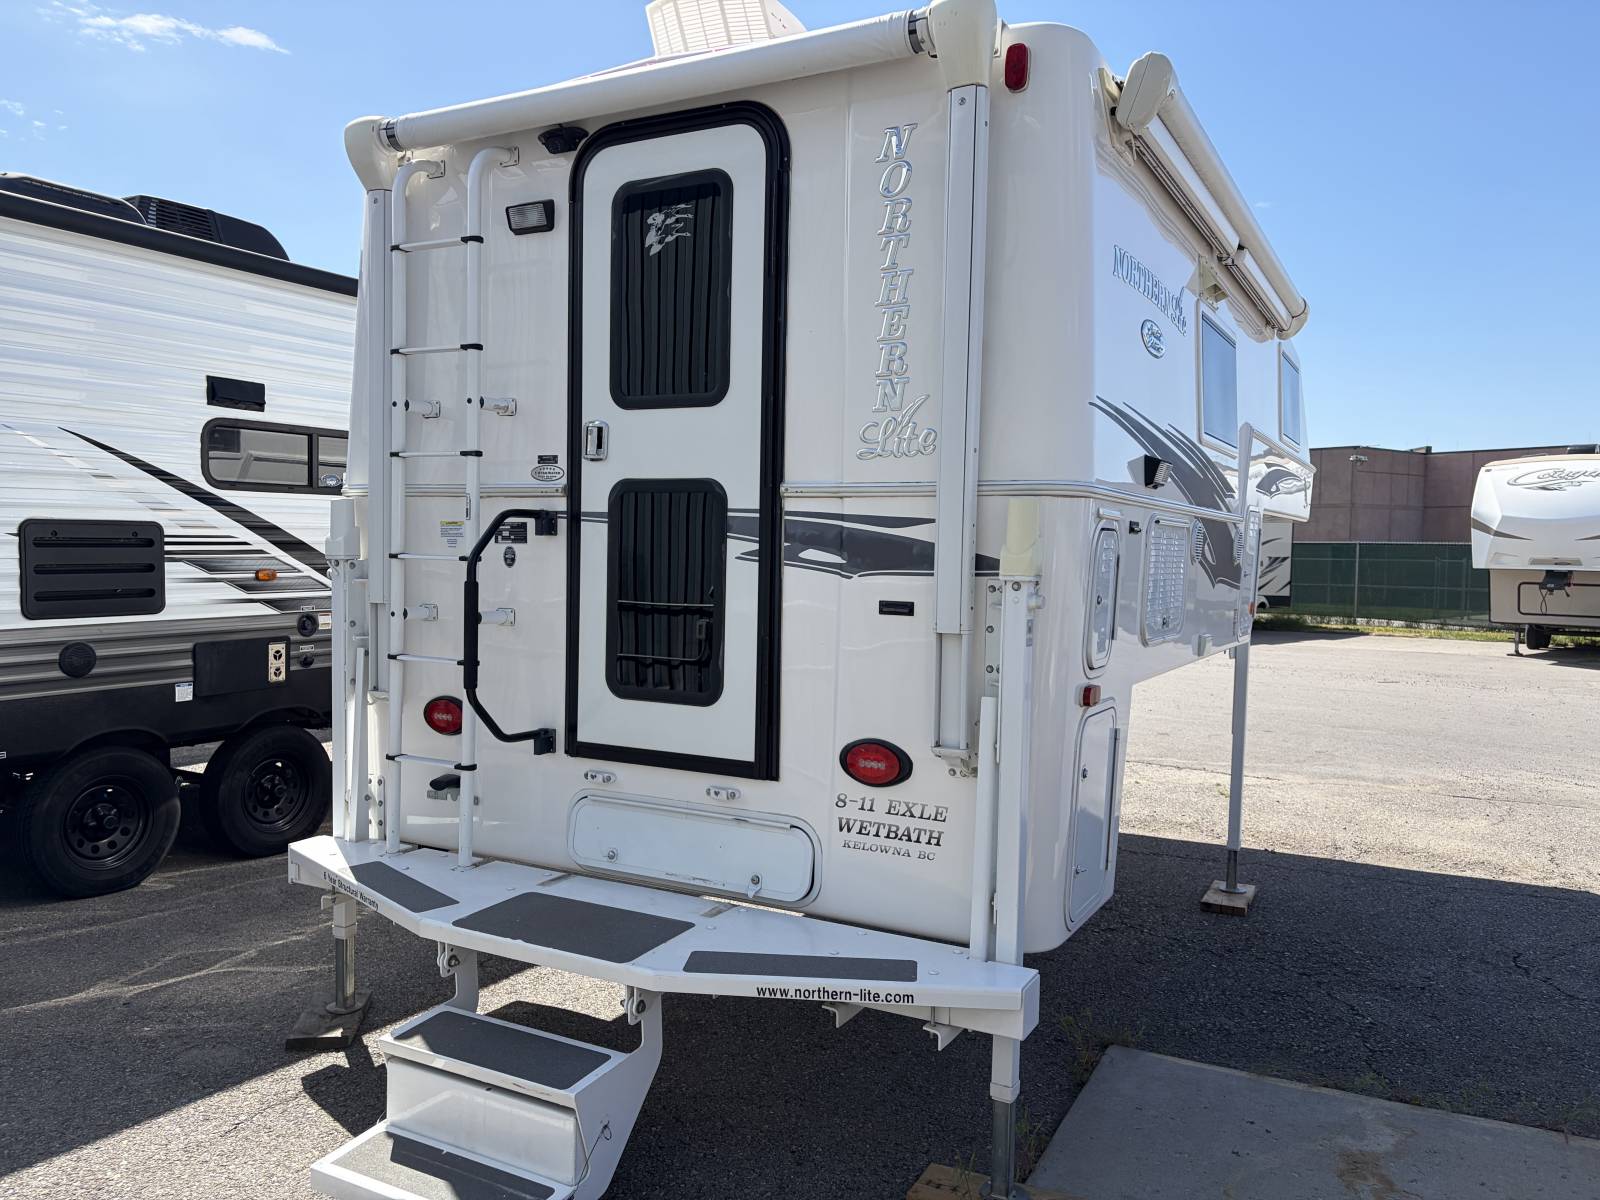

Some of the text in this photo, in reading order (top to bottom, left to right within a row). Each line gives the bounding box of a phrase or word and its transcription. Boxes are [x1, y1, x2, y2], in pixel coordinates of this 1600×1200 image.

[872, 122, 918, 413] NORTHERN
[1113, 244, 1171, 319] NORTHERN
[856, 394, 938, 461] Lite
[835, 793, 949, 823] 8-11 EXLE
[837, 816, 945, 847] WETBATH
[842, 839, 936, 861] KELOWNA BC
[337, 879, 359, 898] Structural
[360, 891, 379, 911] Warranty
[756, 986, 915, 1004] www.northern-lite.com
